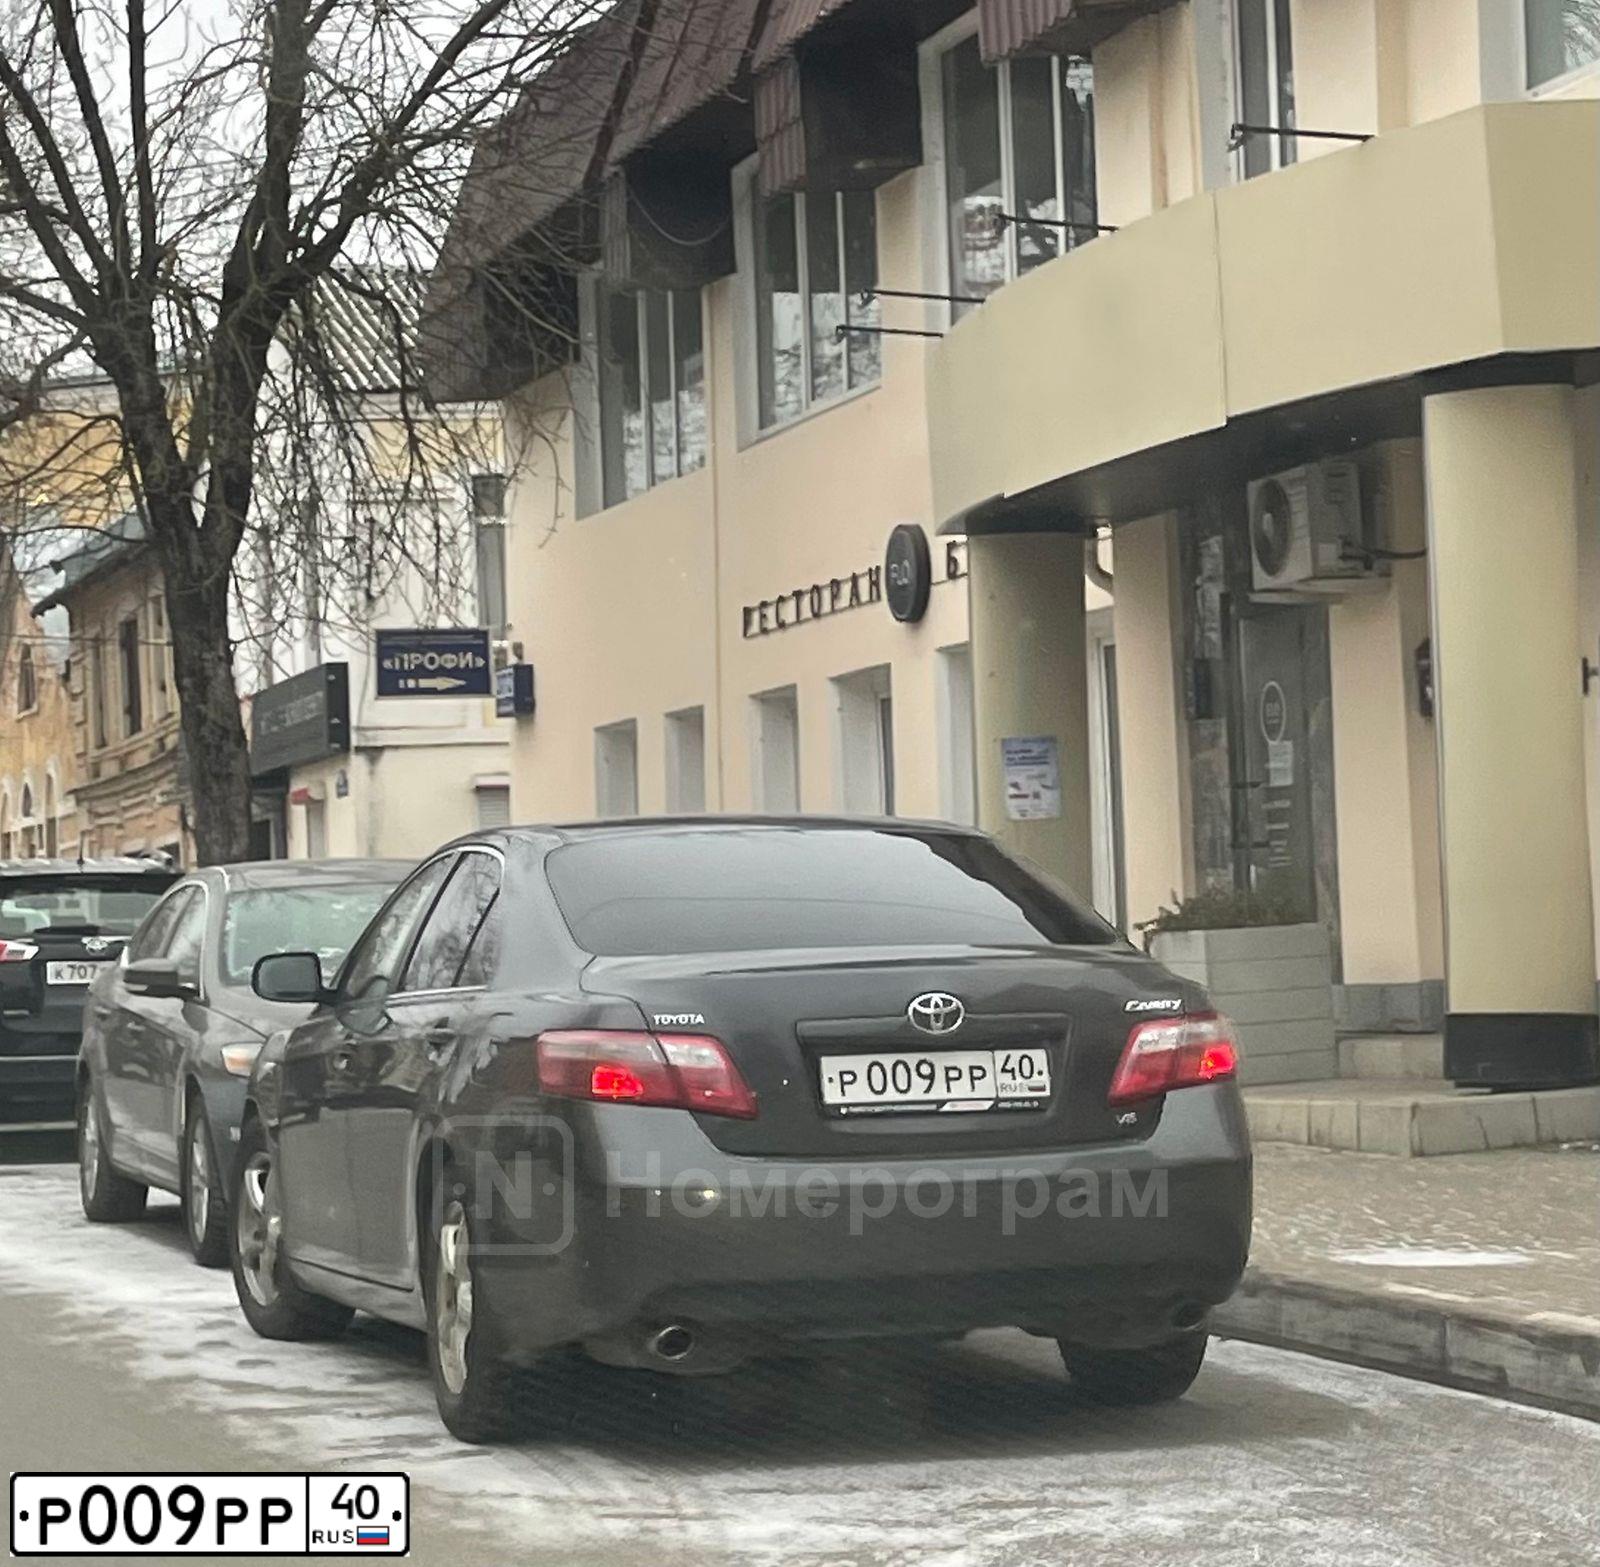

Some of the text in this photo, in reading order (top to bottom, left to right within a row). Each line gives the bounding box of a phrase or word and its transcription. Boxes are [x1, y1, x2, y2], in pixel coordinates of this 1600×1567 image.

[743, 565, 881, 638] РЕСТОРАН
[653, 1013, 705, 1025] TOYOTA
[1000, 1053, 1034, 1081] 40
